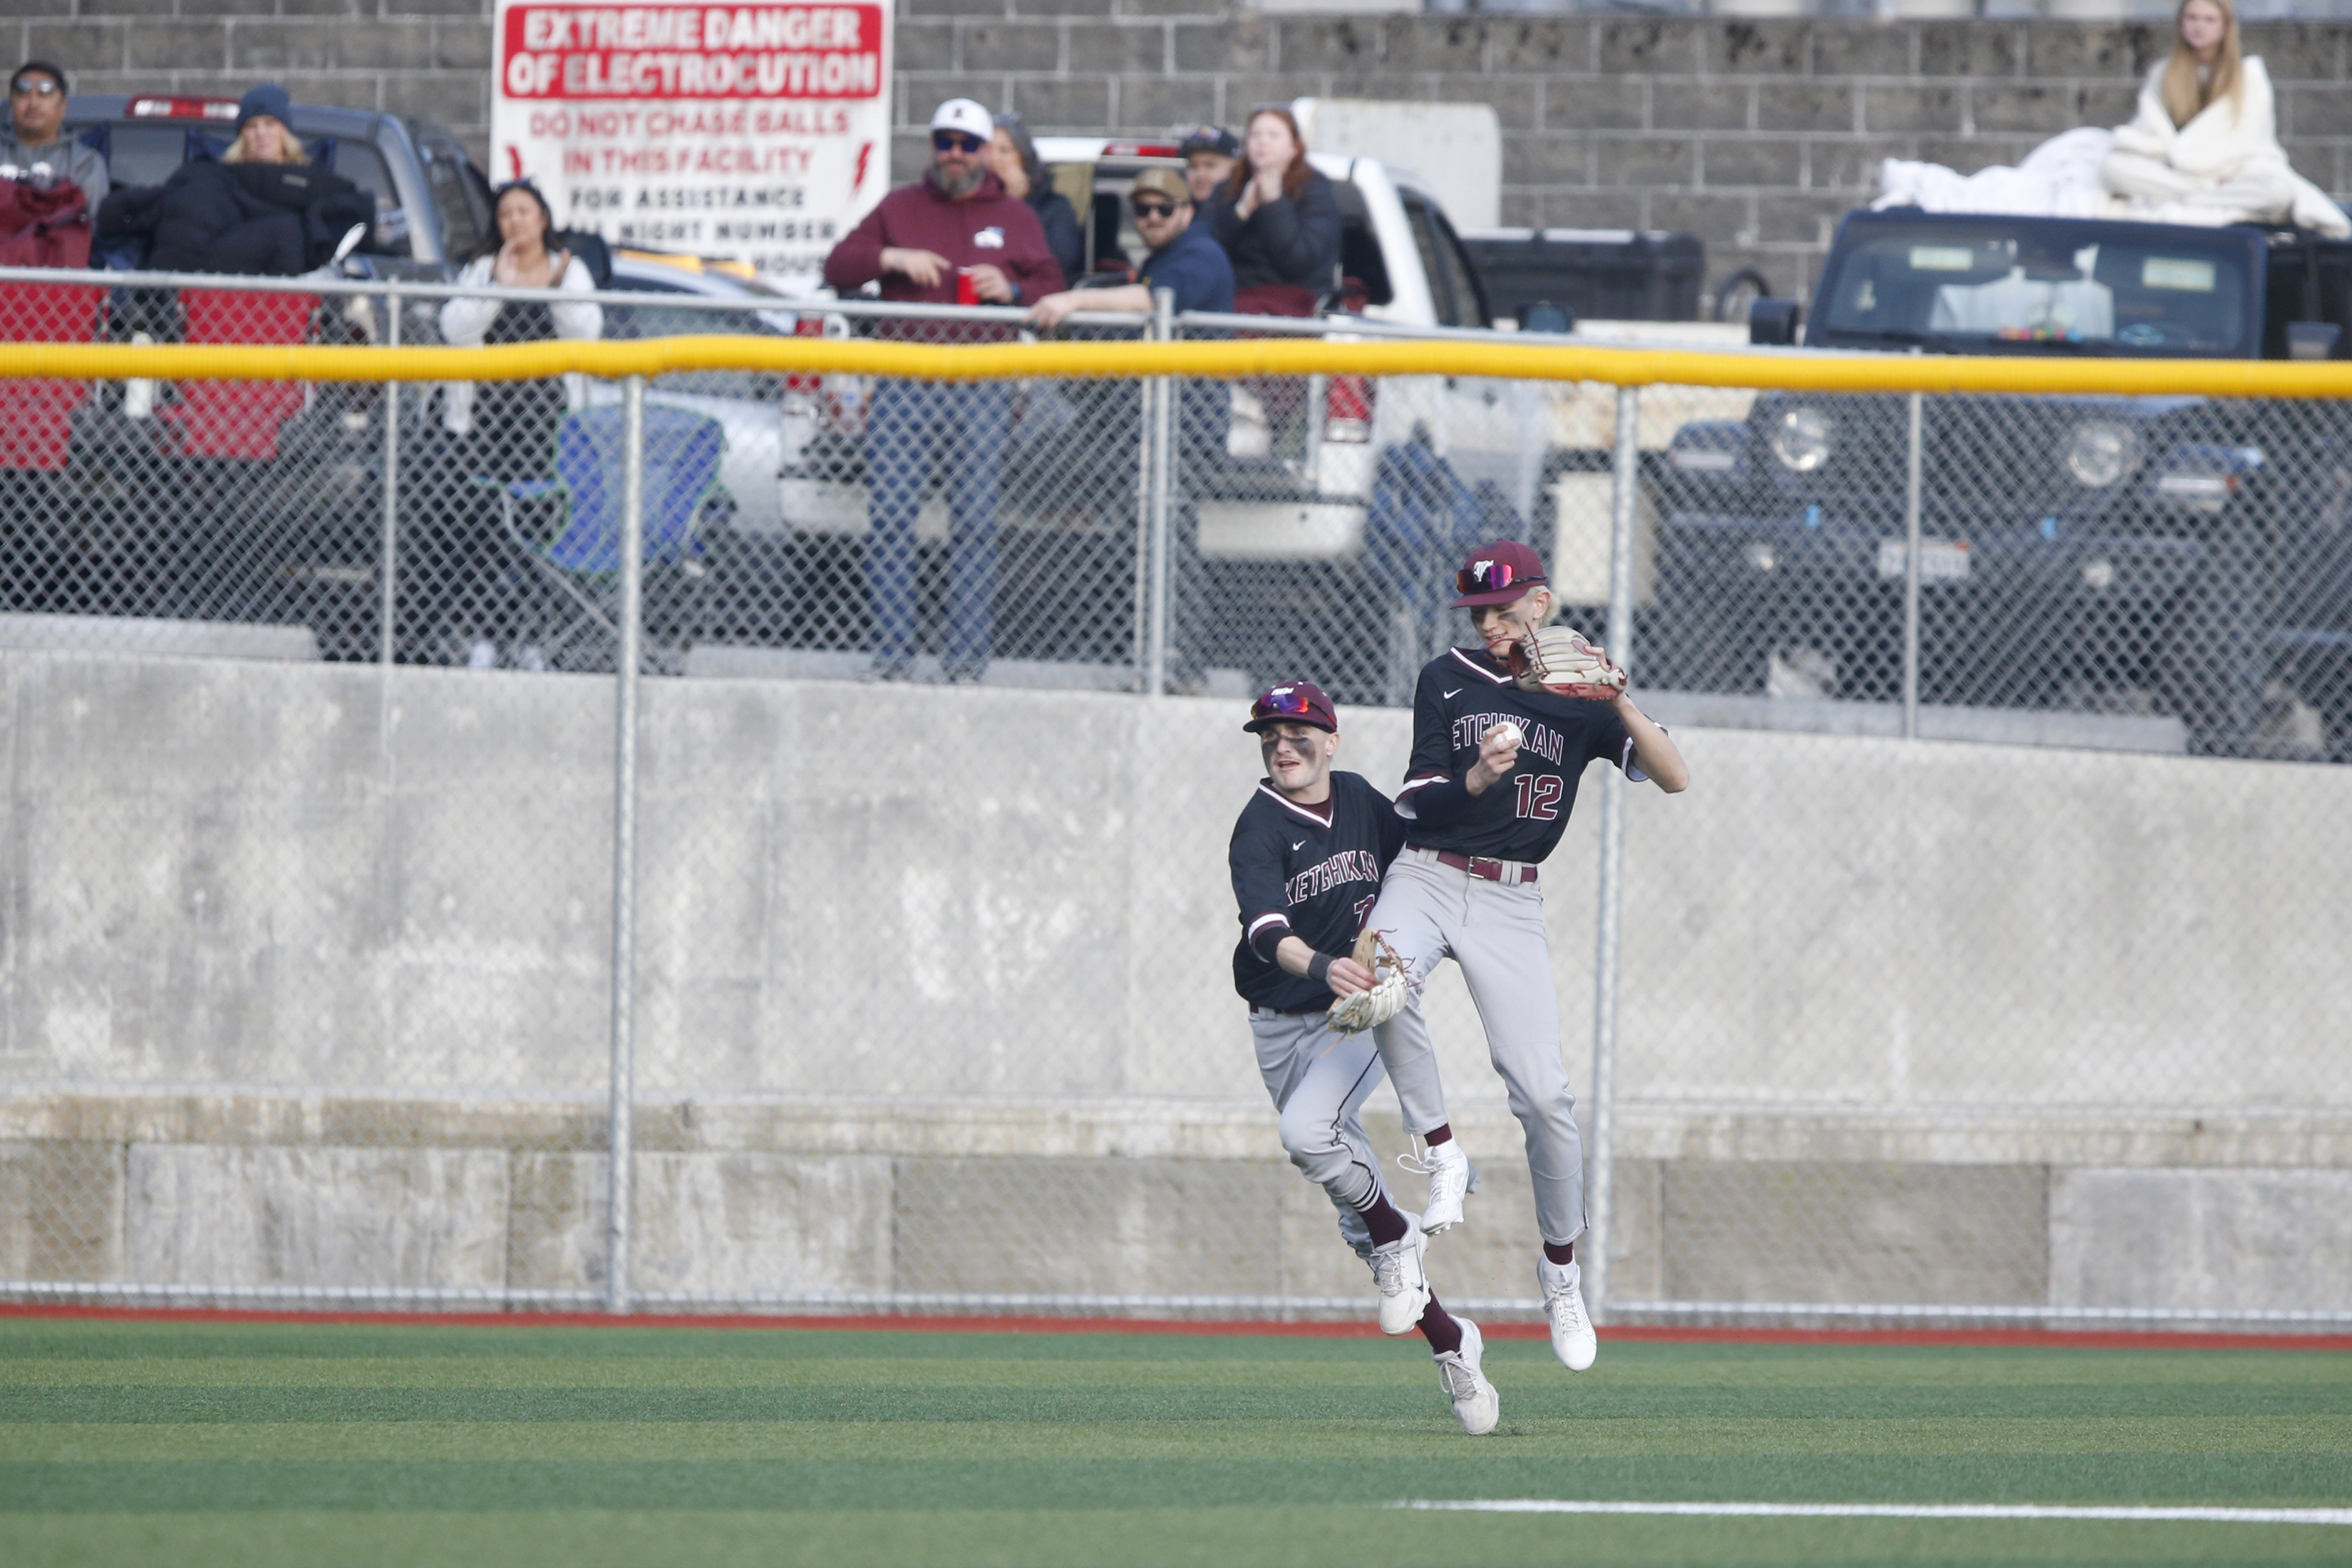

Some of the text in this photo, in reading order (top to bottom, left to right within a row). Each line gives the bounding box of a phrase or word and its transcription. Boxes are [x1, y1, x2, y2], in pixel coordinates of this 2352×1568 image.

[525, 8, 860, 50] EXTREME DANGER
[507, 51, 877, 94] OF ELECTROCUTION
[530, 110, 850, 138] DO NOT CHASE BALLS
[563, 146, 814, 172] IN THIS FACILITY
[571, 185, 805, 208] FOR ASSISTANCE
[715, 220, 837, 241] NUMBER
[1515, 774, 1564, 820] 12
